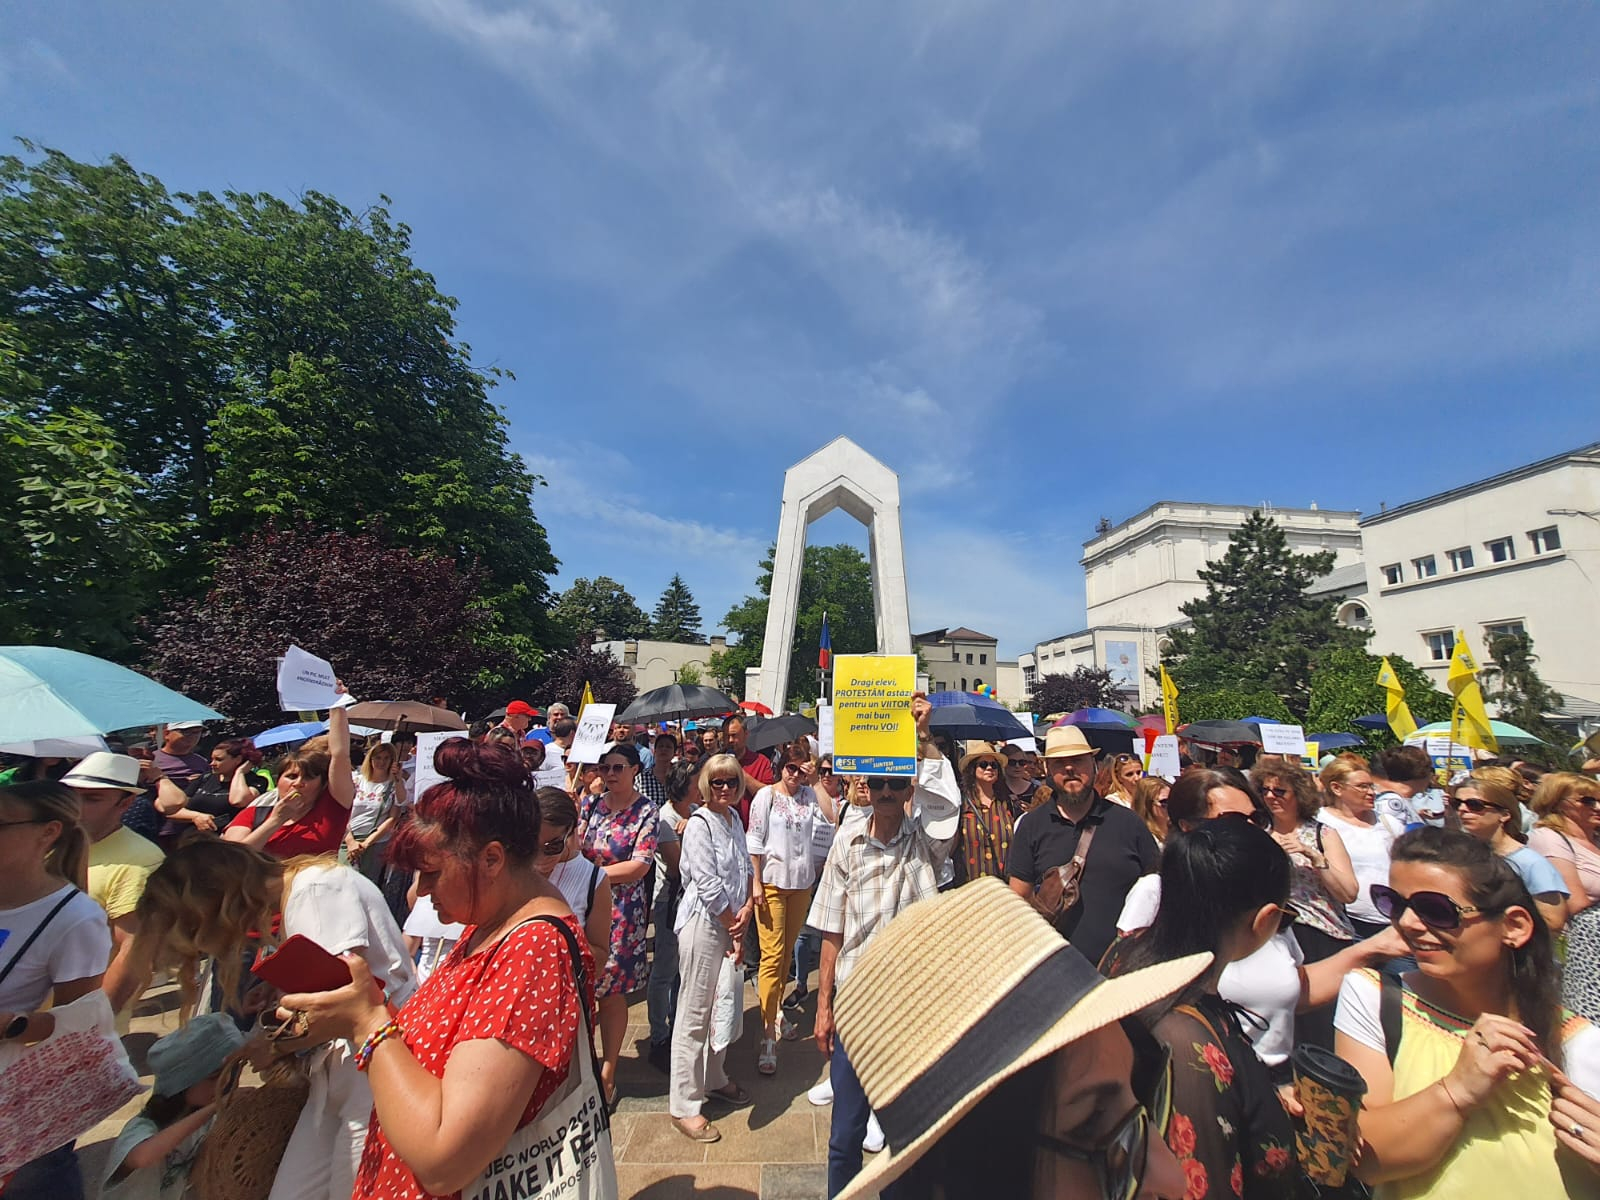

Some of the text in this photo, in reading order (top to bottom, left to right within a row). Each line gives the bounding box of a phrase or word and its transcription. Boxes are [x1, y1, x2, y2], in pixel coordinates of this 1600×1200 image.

[850, 678, 897, 687] Dragi elevi,
[835, 688, 885, 697] PROTESTĂM
[839, 701, 867, 710] pentru
[880, 700, 910, 709] VIITOR
[856, 711, 890, 719] mai bun
[850, 722, 899, 732] pentru VOI!
[485, 1095, 596, 1180] JEC WORLD 2018
[545, 1147, 564, 1184] IT
